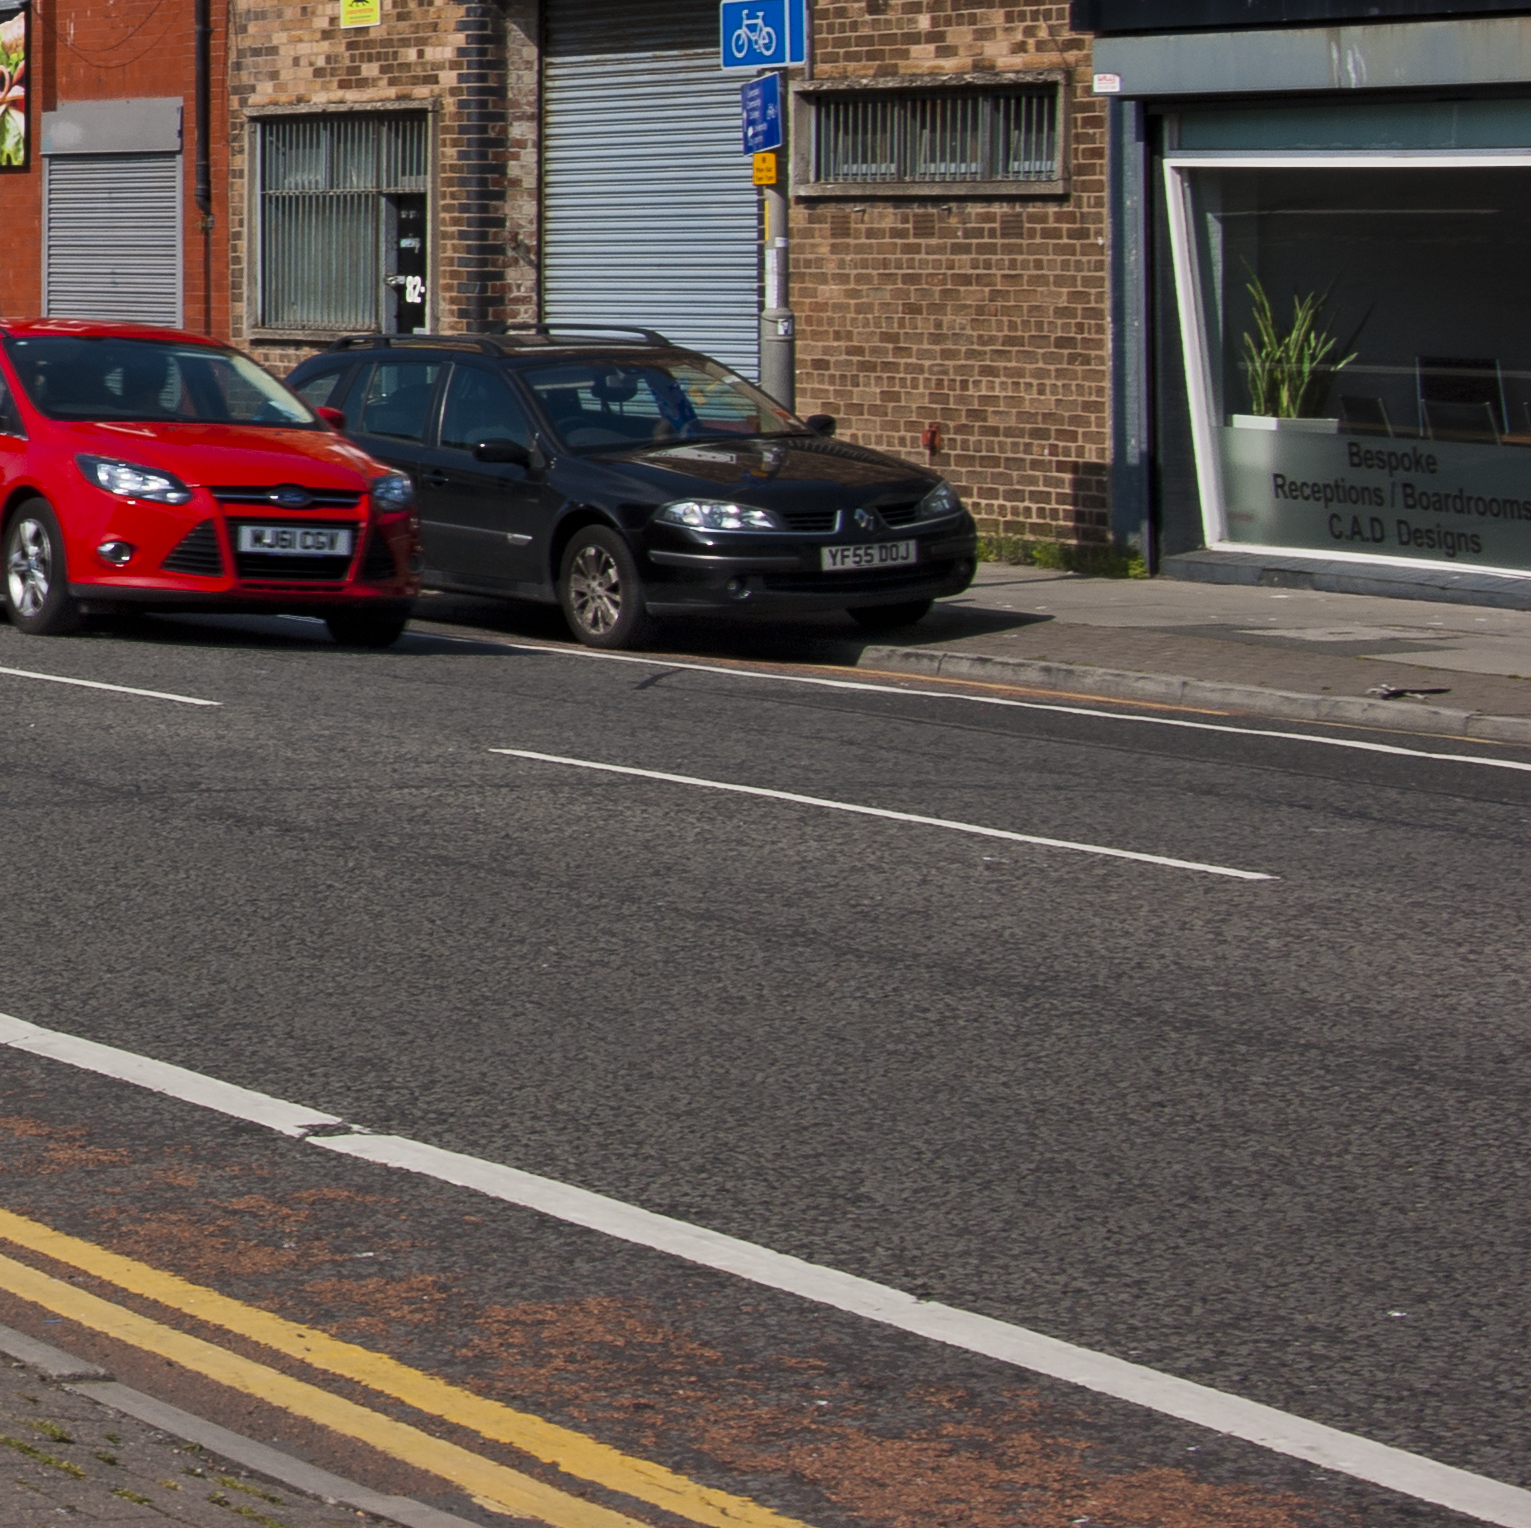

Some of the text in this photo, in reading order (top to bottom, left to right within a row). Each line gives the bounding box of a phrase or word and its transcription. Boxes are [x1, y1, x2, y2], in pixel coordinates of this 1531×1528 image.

[1348, 442, 1438, 475] Bespoke
[1273, 473, 1386, 508] Receptions
[1402, 482, 1531, 521] Boardrooms
[828, 542, 910, 567] YF55 DOJ
[1329, 513, 1484, 559] C.A.D Designs
